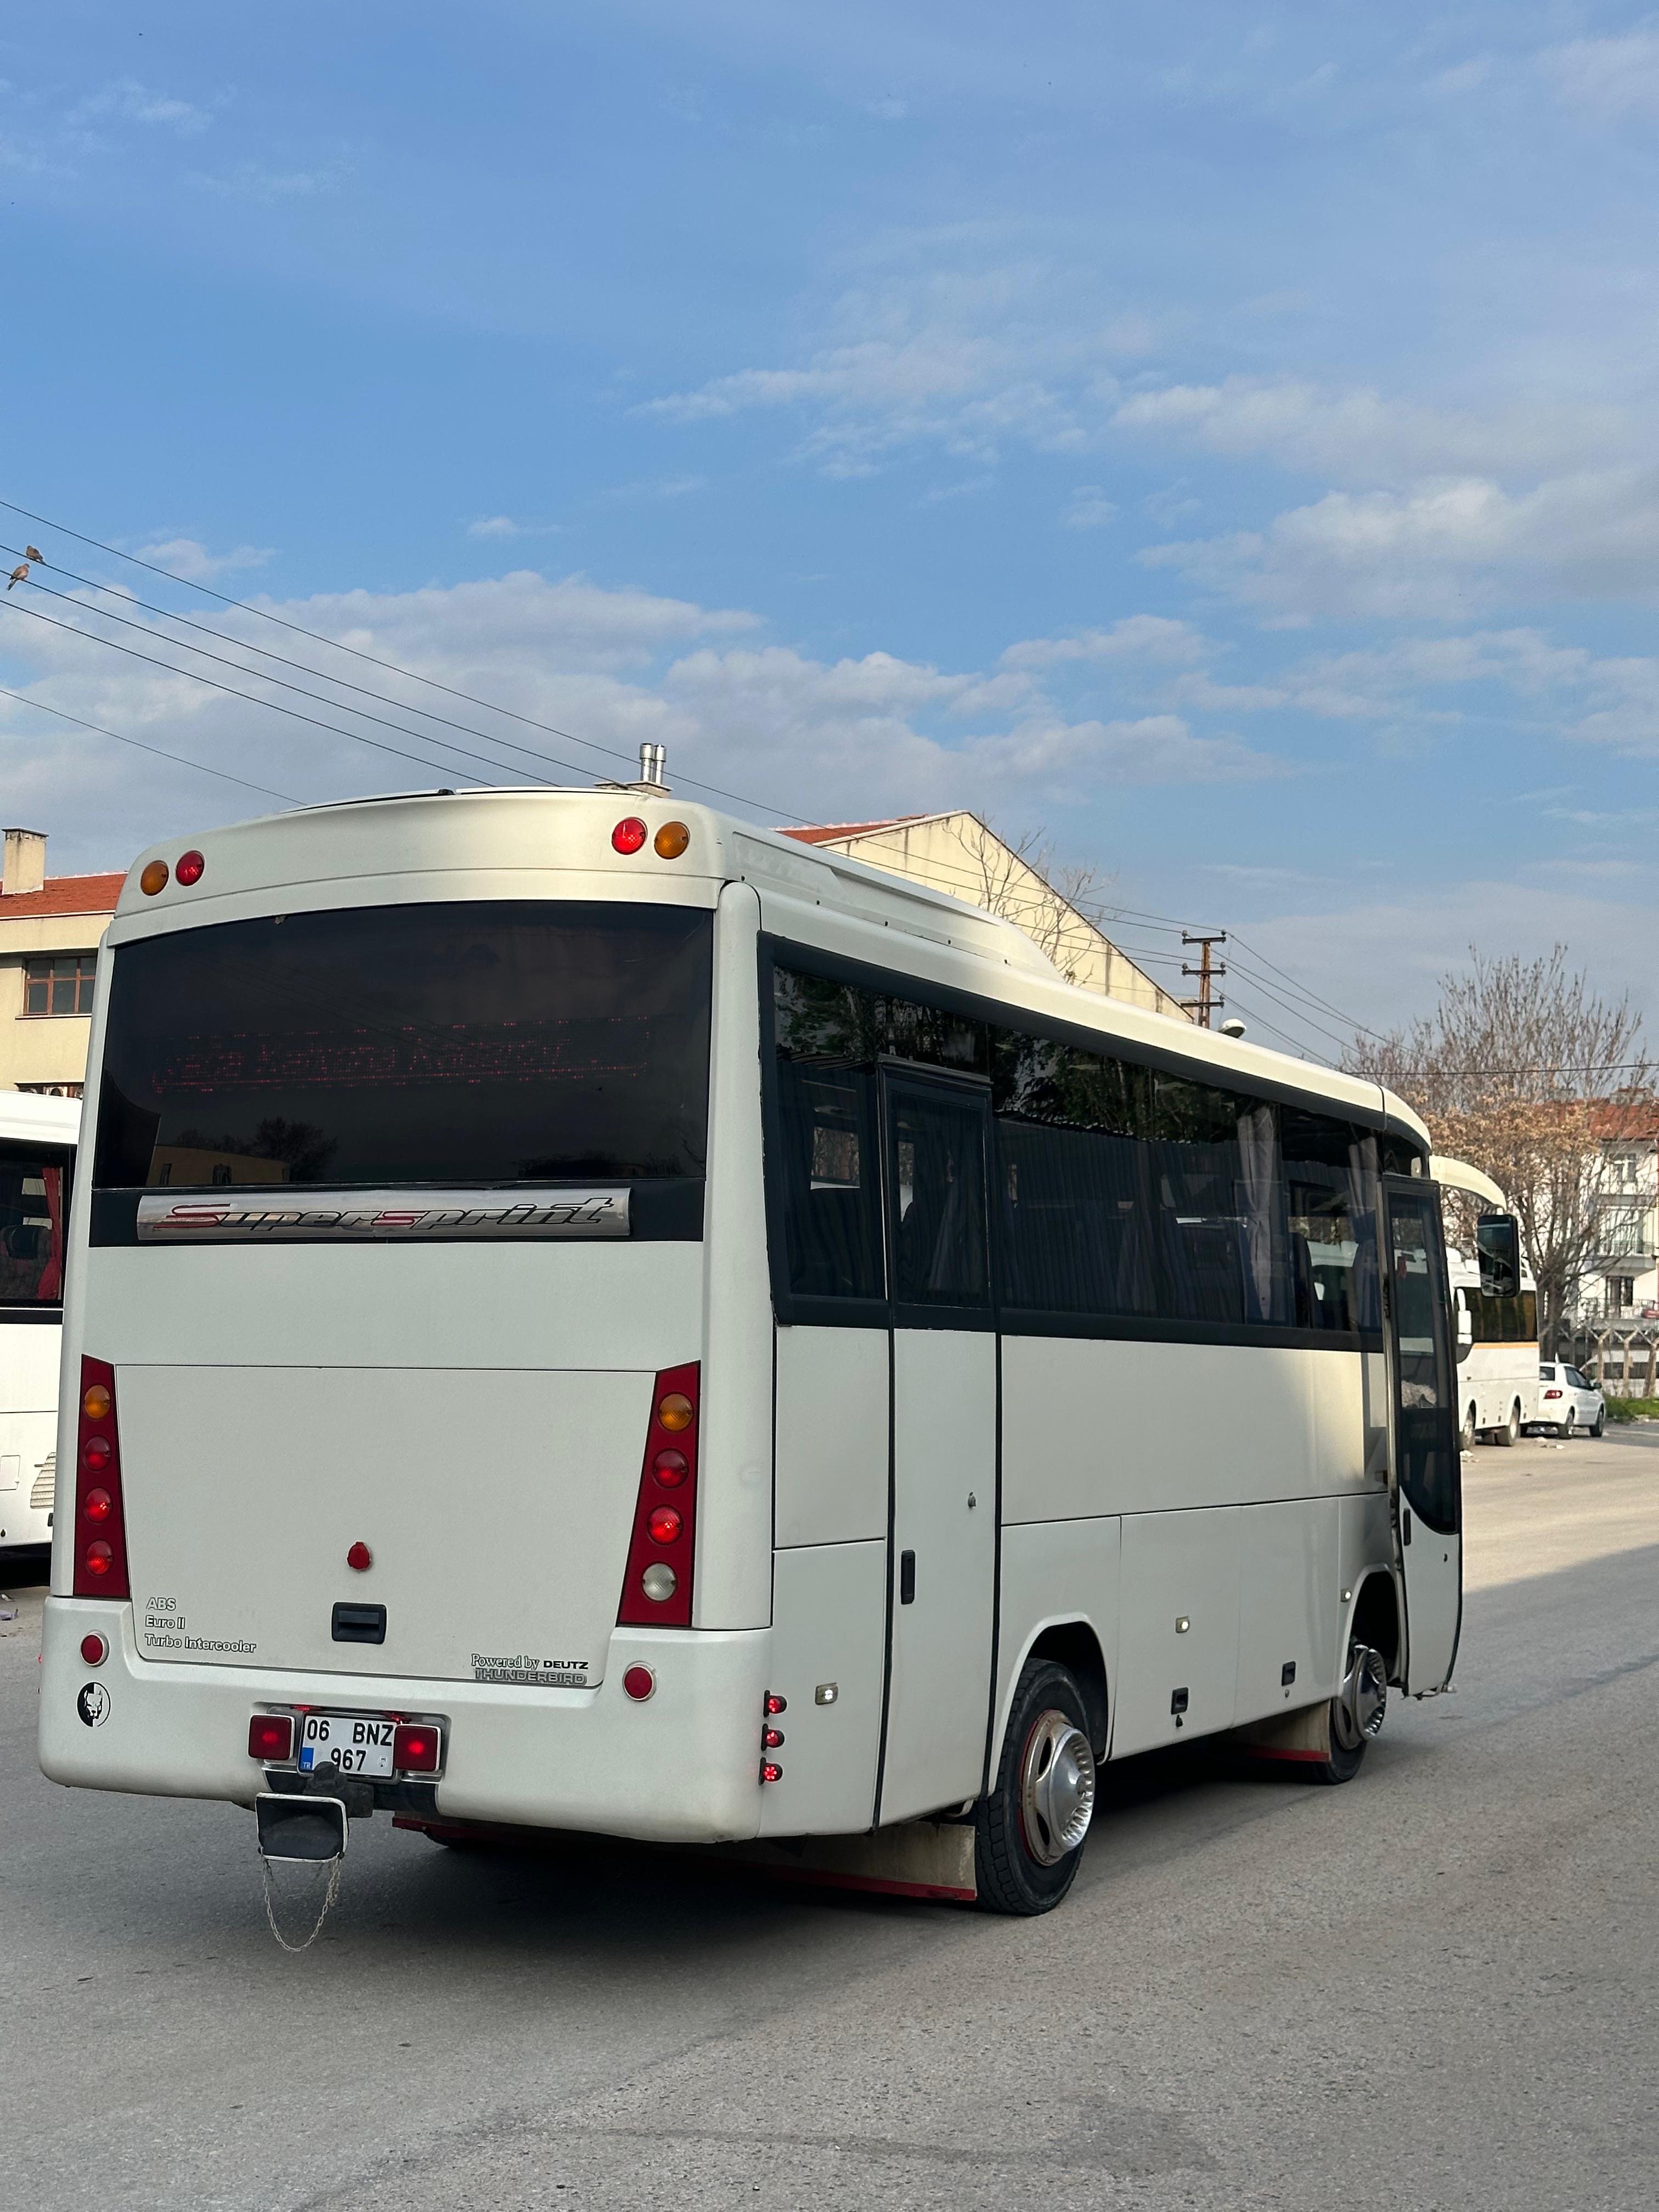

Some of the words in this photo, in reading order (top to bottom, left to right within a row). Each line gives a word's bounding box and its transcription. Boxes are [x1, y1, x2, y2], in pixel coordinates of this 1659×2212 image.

[146, 1597, 176, 1611] ABS
[145, 1615, 175, 1629] Euro
[177, 1617, 185, 1629] II
[145, 1633, 182, 1648] Turbo
[184, 1636, 256, 1653] Intercooler
[471, 1653, 522, 1668] Powered
[524, 1655, 540, 1671] by
[543, 1660, 589, 1669] DEUTZ
[475, 1667, 587, 1685] THUNDERBIRD
[307, 1719, 330, 1741] 06
[353, 1722, 394, 1746] BNZ
[331, 1748, 366, 1771] 967
